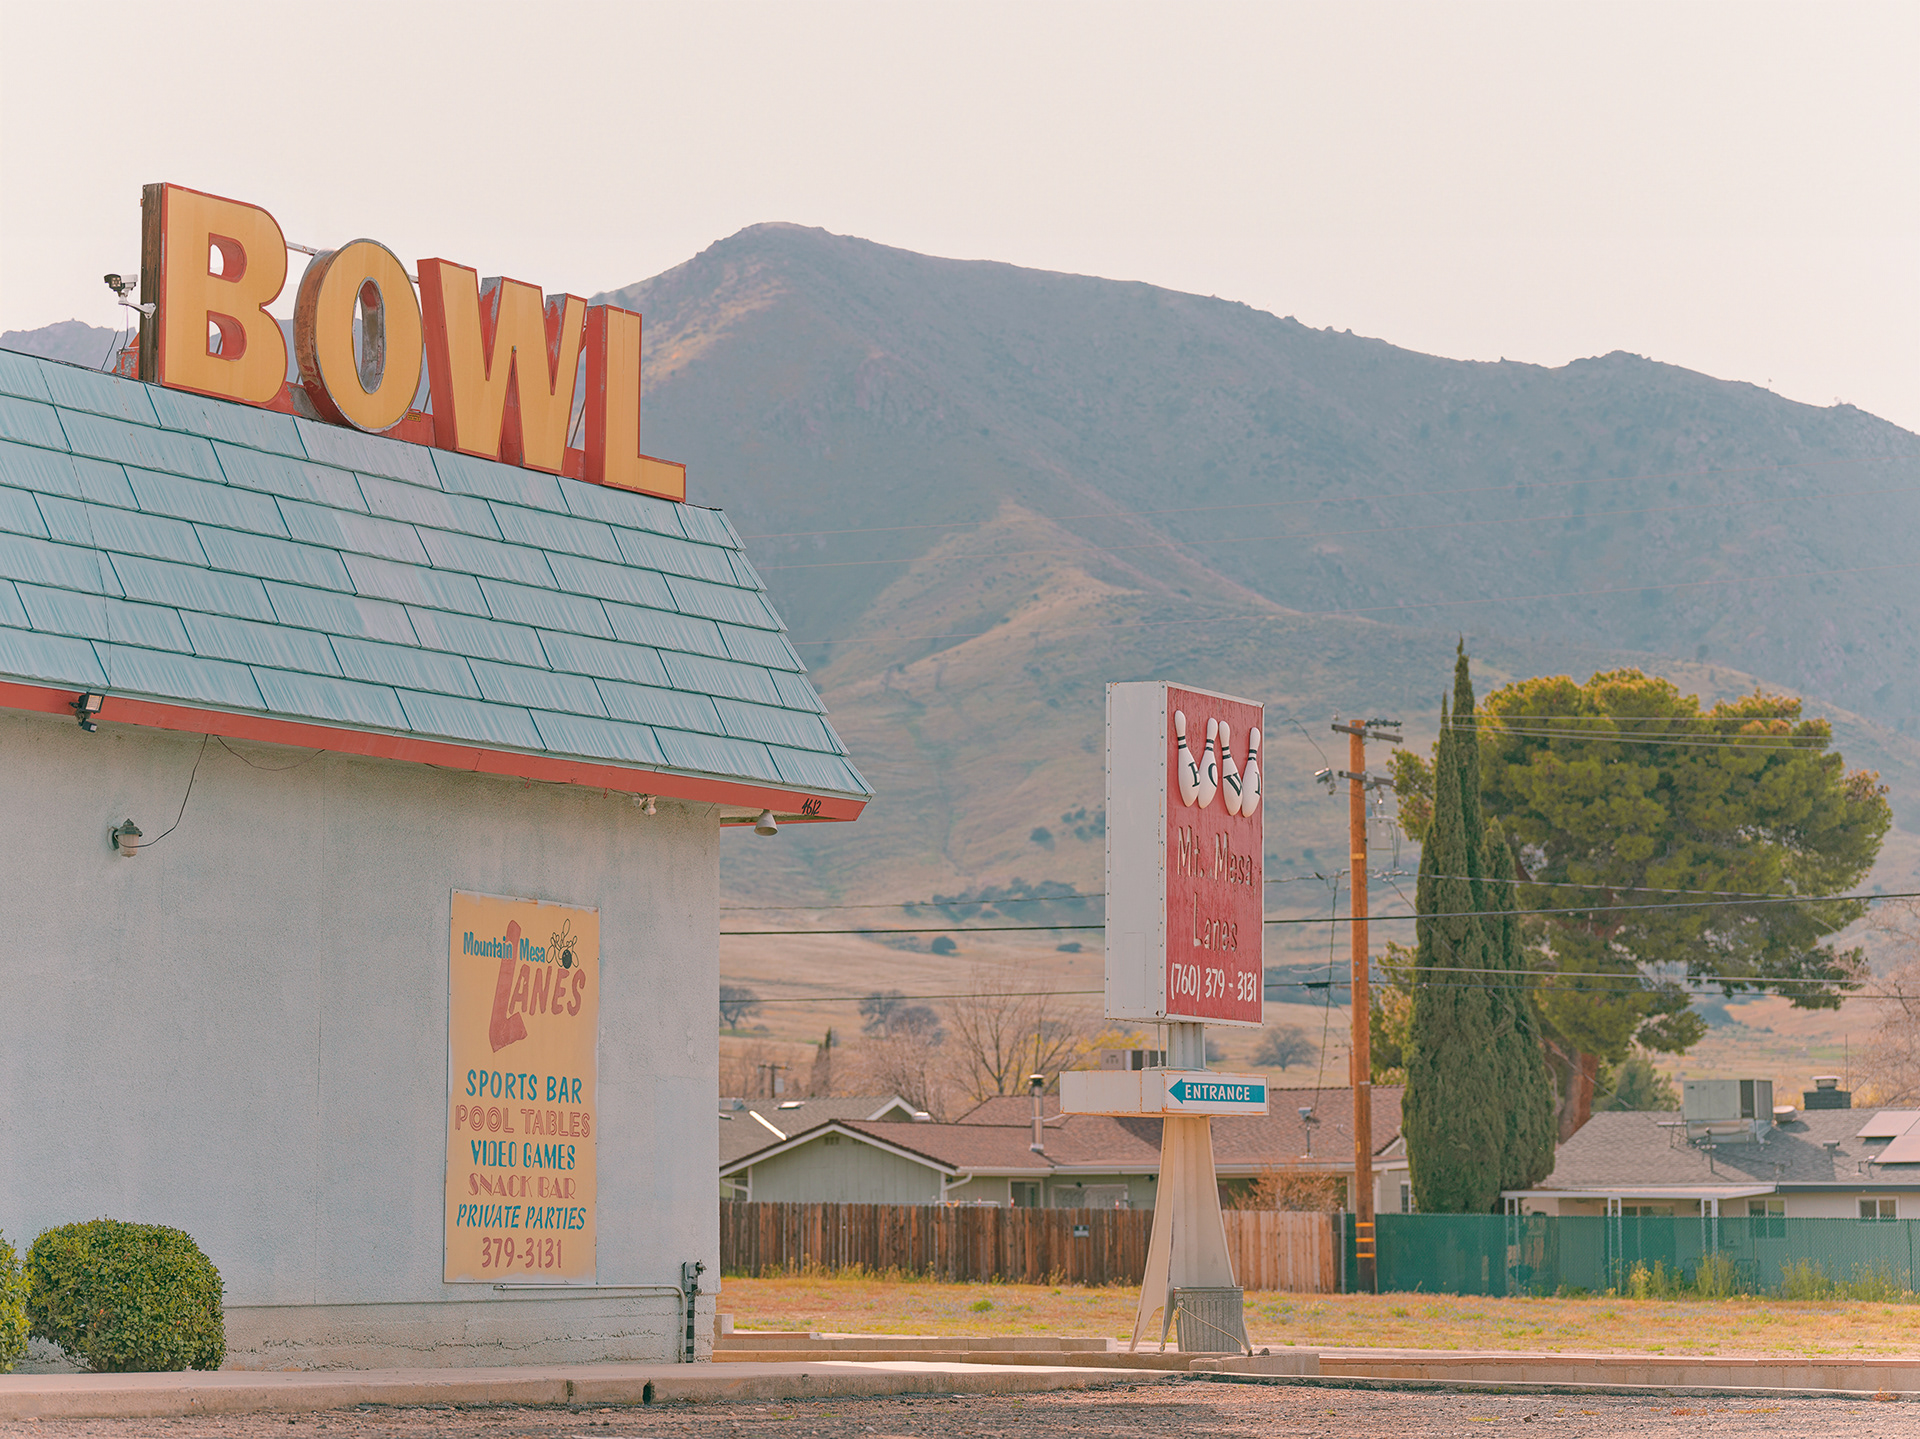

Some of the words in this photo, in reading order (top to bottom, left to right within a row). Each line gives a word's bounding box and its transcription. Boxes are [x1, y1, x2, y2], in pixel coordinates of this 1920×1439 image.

[140, 182, 686, 502] BOWL
[801, 798, 822, 815] 4612
[1215, 831, 1253, 886] Mesa
[1193, 892, 1238, 952] Lanes
[463, 931, 513, 959] Mountain
[519, 938, 546, 963] Mesa
[489, 920, 586, 1053] LANES
[1170, 962, 1201, 1002] (760)
[1205, 967, 1226, 999] 379
[1237, 970, 1258, 1002] 3131
[466, 1069, 538, 1101] SPORTS
[546, 1076, 582, 1104] BAR
[1185, 1084, 1251, 1101] ENTRANCE
[455, 1104, 515, 1133] POOL
[520, 1108, 591, 1138] TABLES
[471, 1139, 517, 1168] VIDEO
[523, 1142, 576, 1170] GAMES
[468, 1172, 533, 1198] SNACK
[537, 1176, 577, 1200] BAR
[456, 1203, 522, 1229] PRIVATE
[525, 1206, 587, 1230] PARTIES
[481, 1236, 562, 1269] 379-3131
